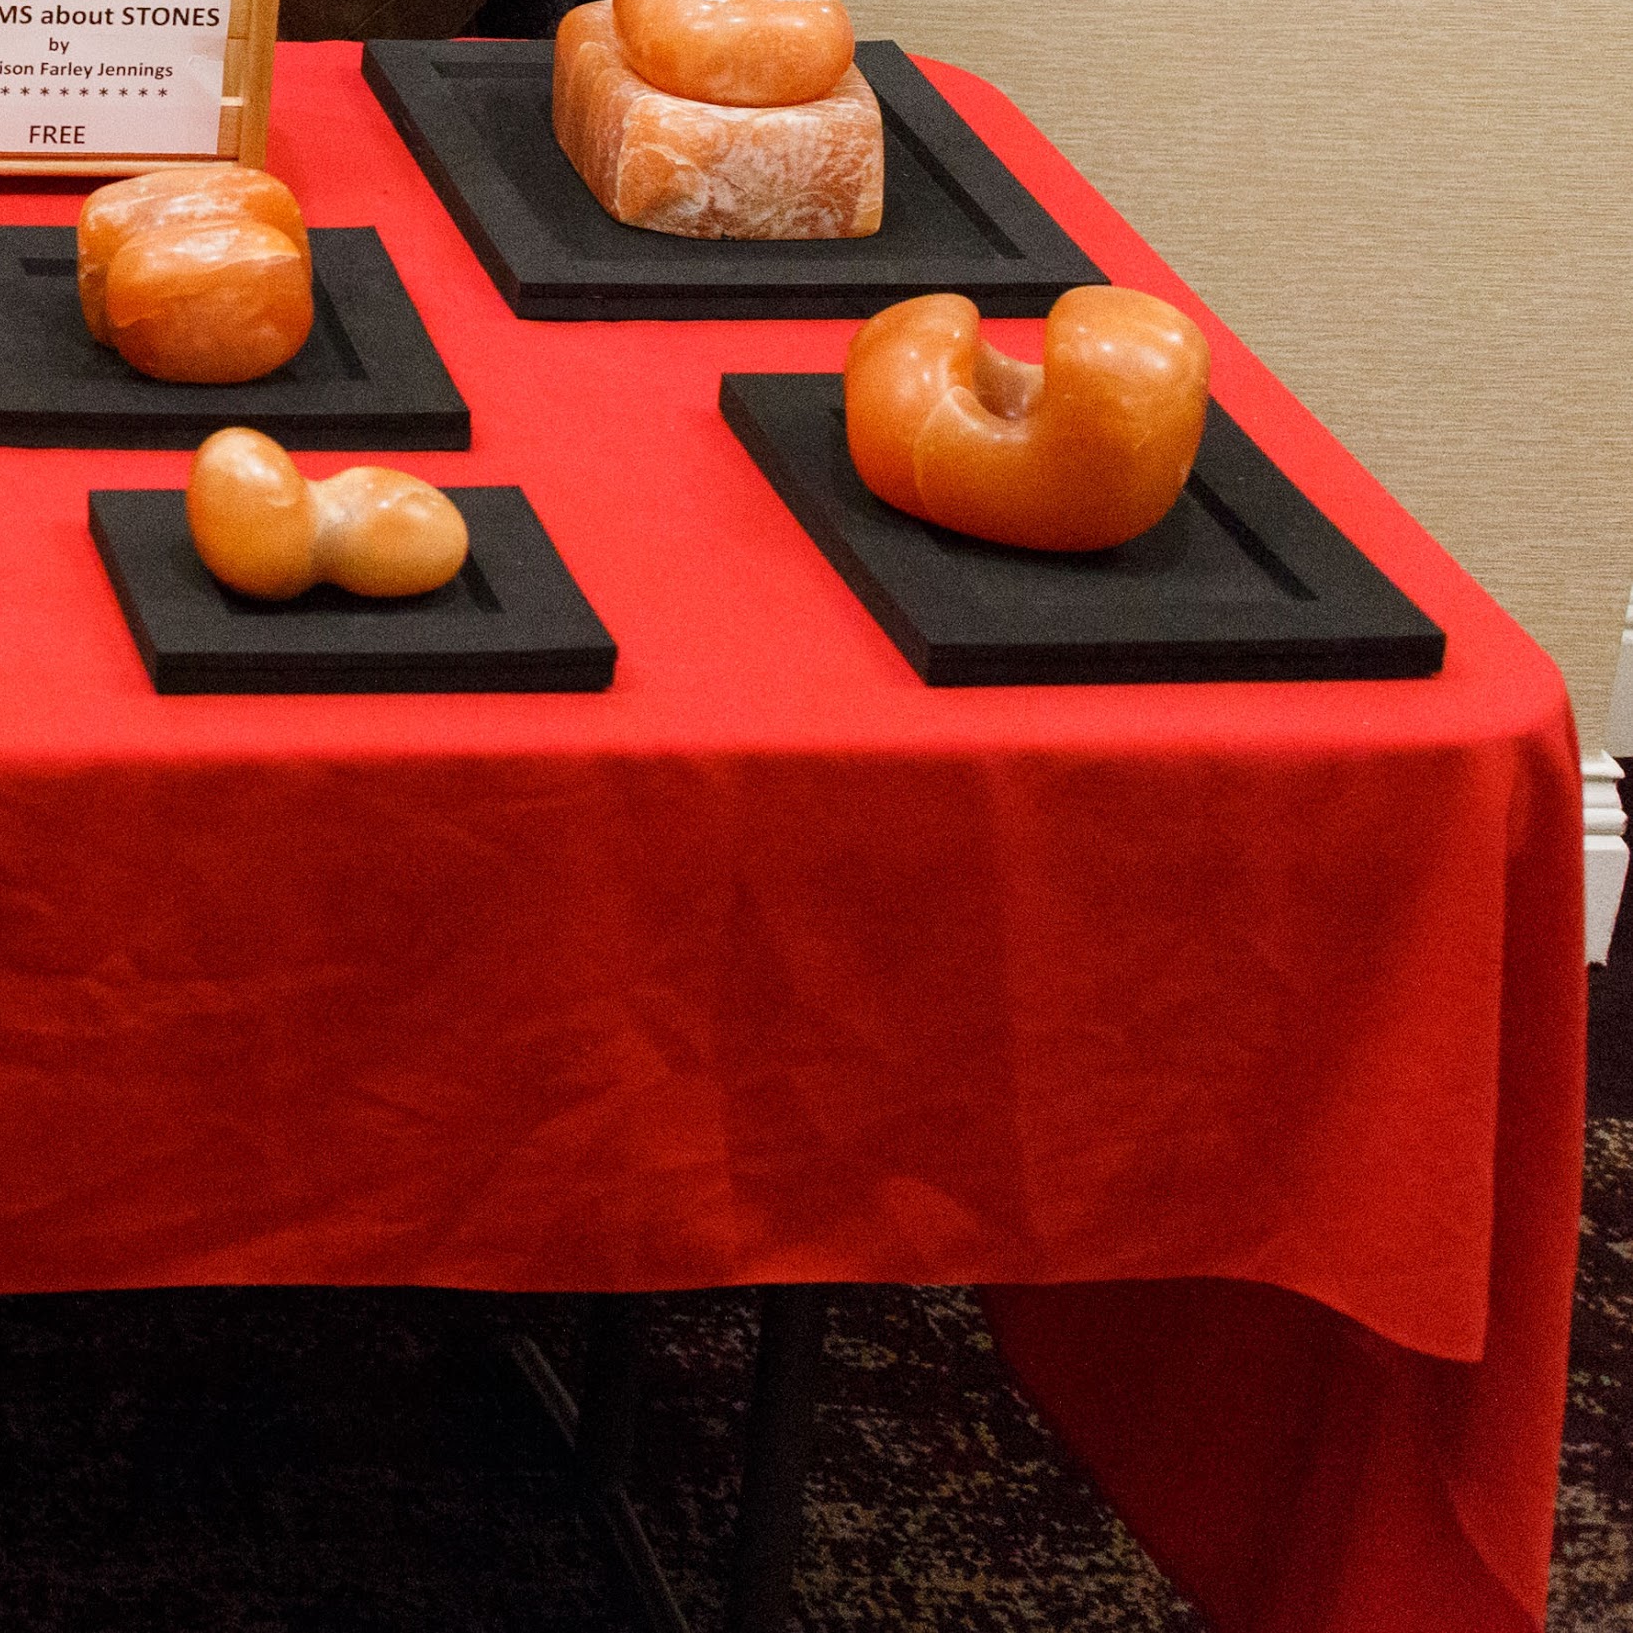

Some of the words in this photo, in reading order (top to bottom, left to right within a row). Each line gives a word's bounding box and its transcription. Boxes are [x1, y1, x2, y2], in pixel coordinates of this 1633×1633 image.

[40, 4, 113, 26] about
[121, 6, 221, 27] STONES
[48, 36, 70, 56] by
[40, 61, 93, 80] Farley
[96, 62, 174, 79] Jennings
[29, 125, 87, 145] FREE
